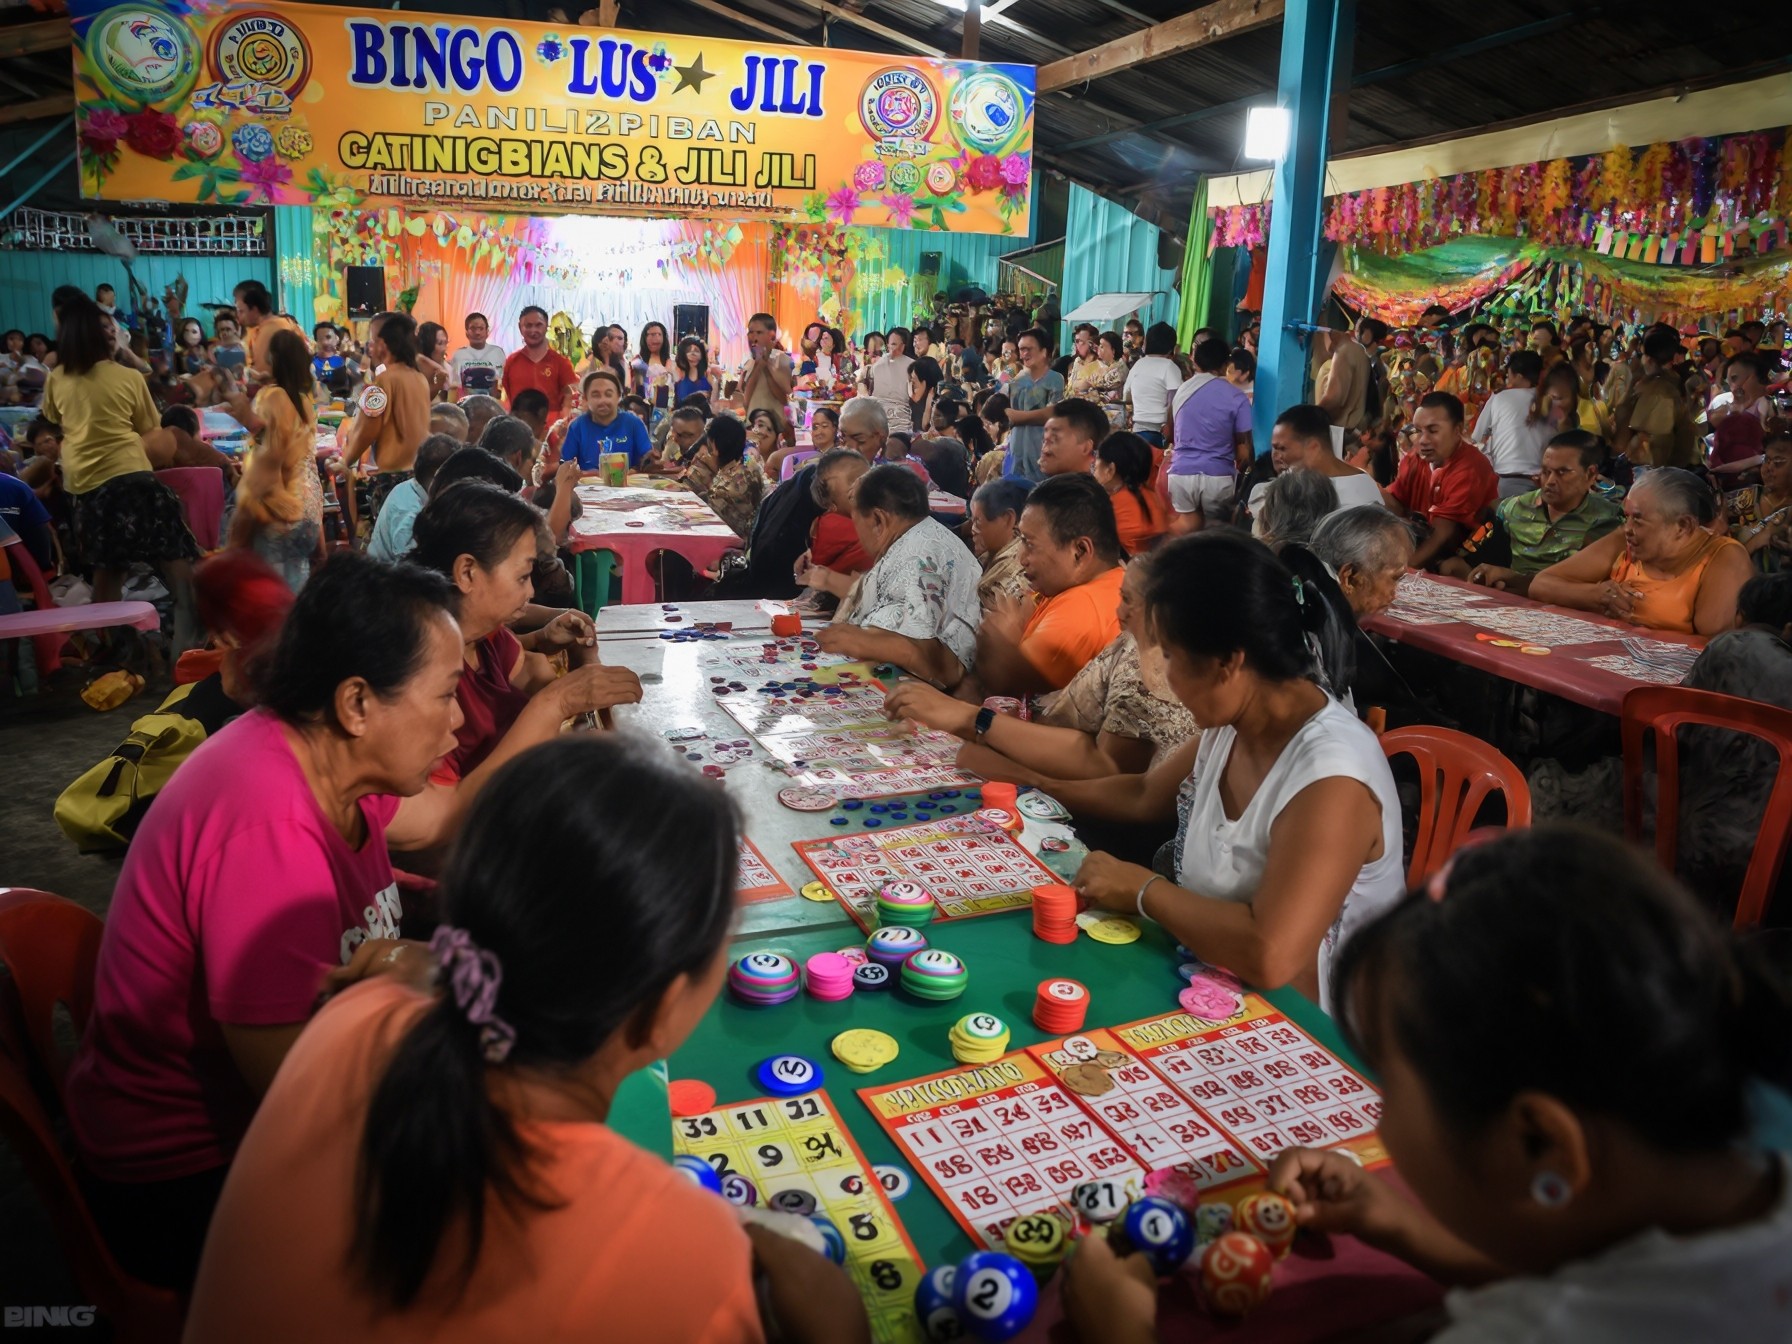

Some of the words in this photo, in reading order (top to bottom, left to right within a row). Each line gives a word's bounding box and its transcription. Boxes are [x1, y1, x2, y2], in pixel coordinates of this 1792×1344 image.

[347, 22, 524, 93] BINGO
[566, 38, 658, 103] LUS
[730, 55, 827, 117] JILI
[338, 131, 629, 179] CATINIGBIANS
[635, 145, 668, 183] &
[675, 148, 747, 187] JILI
[754, 151, 818, 190] JILI
[757, 1144, 784, 1167] 9
[970, 1277, 1000, 1312] 2
